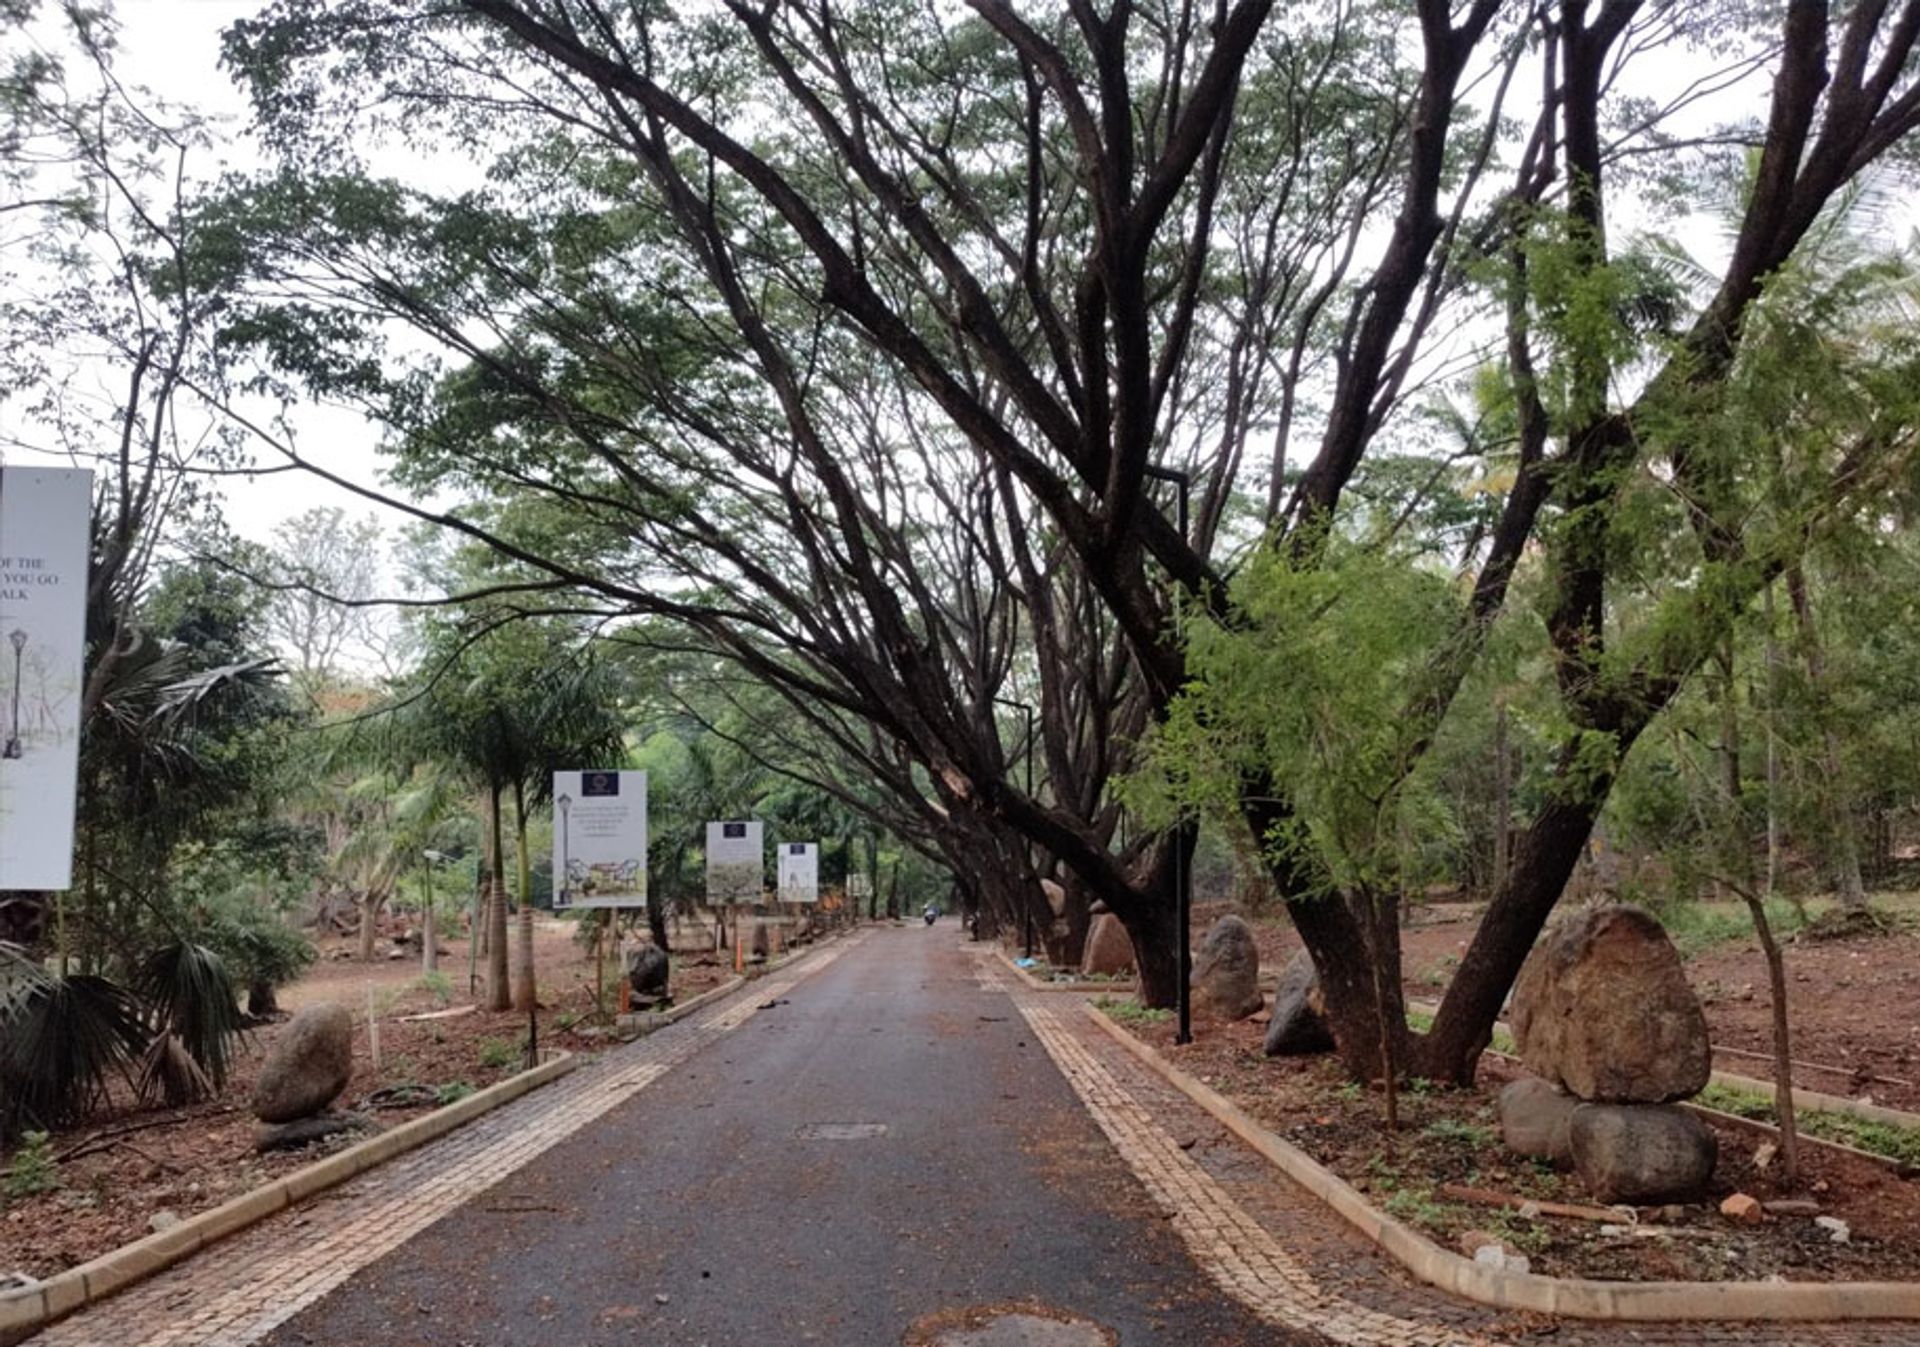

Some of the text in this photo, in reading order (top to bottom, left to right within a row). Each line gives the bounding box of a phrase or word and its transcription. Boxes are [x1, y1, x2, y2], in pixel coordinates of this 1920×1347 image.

[18, 557, 45, 569] THE
[4, 573, 59, 586] YOU GO
